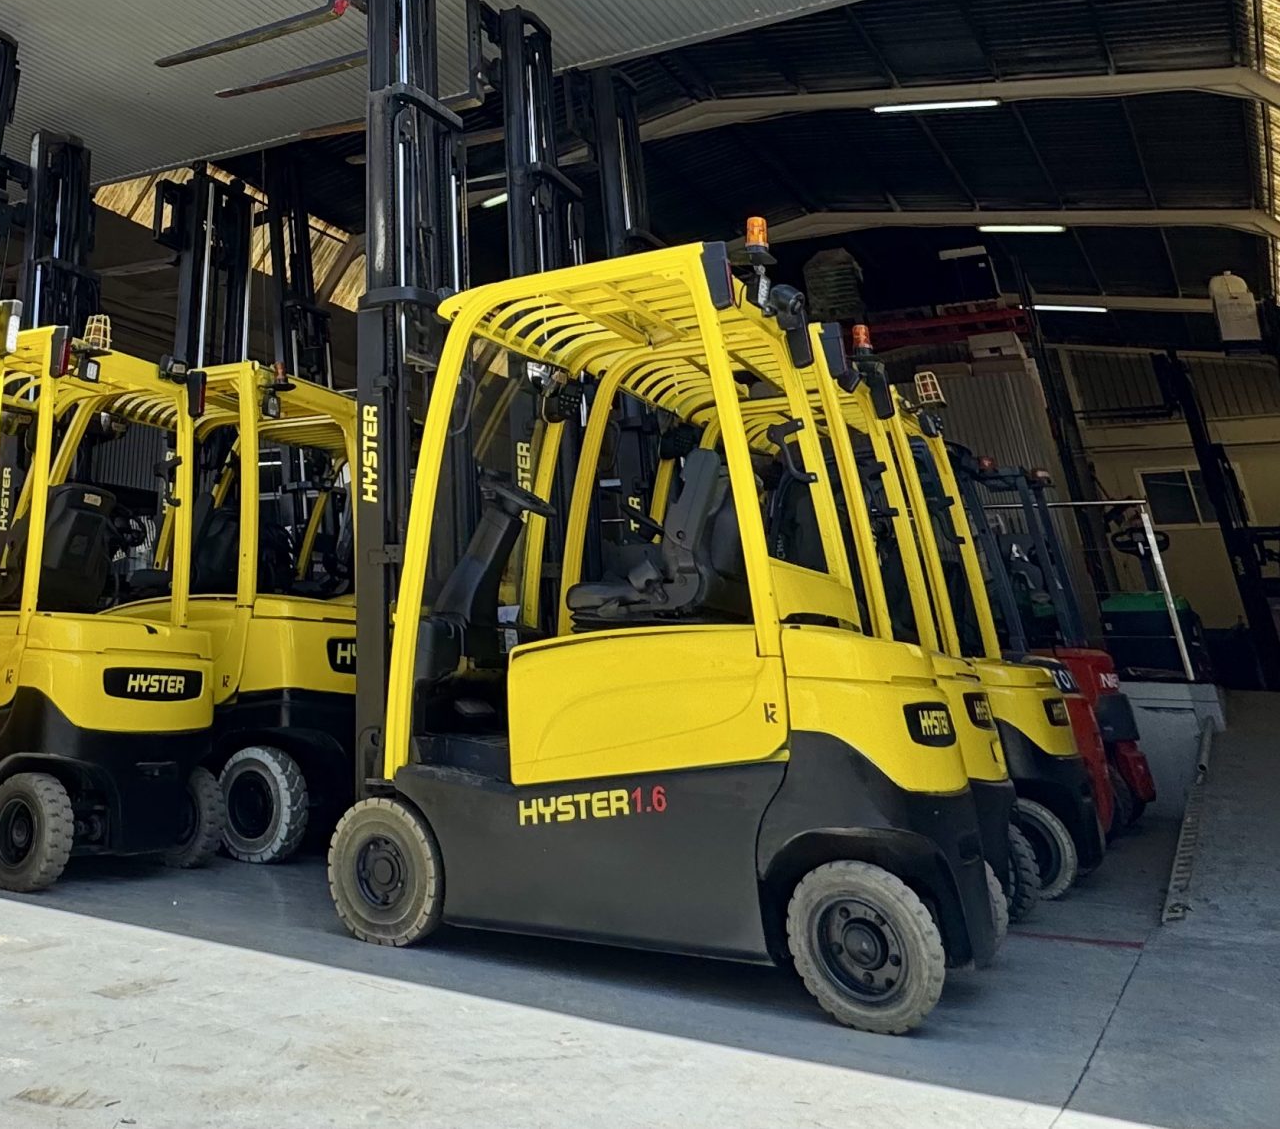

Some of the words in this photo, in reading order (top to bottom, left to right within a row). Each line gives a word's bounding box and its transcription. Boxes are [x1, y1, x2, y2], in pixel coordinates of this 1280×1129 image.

[362, 404, 378, 503] HYSTER
[0, 467, 12, 531] HYSTER
[127, 673, 185, 694] HYSTER
[519, 788, 630, 826] HYSTER
[631, 785, 668, 813] 1.6
